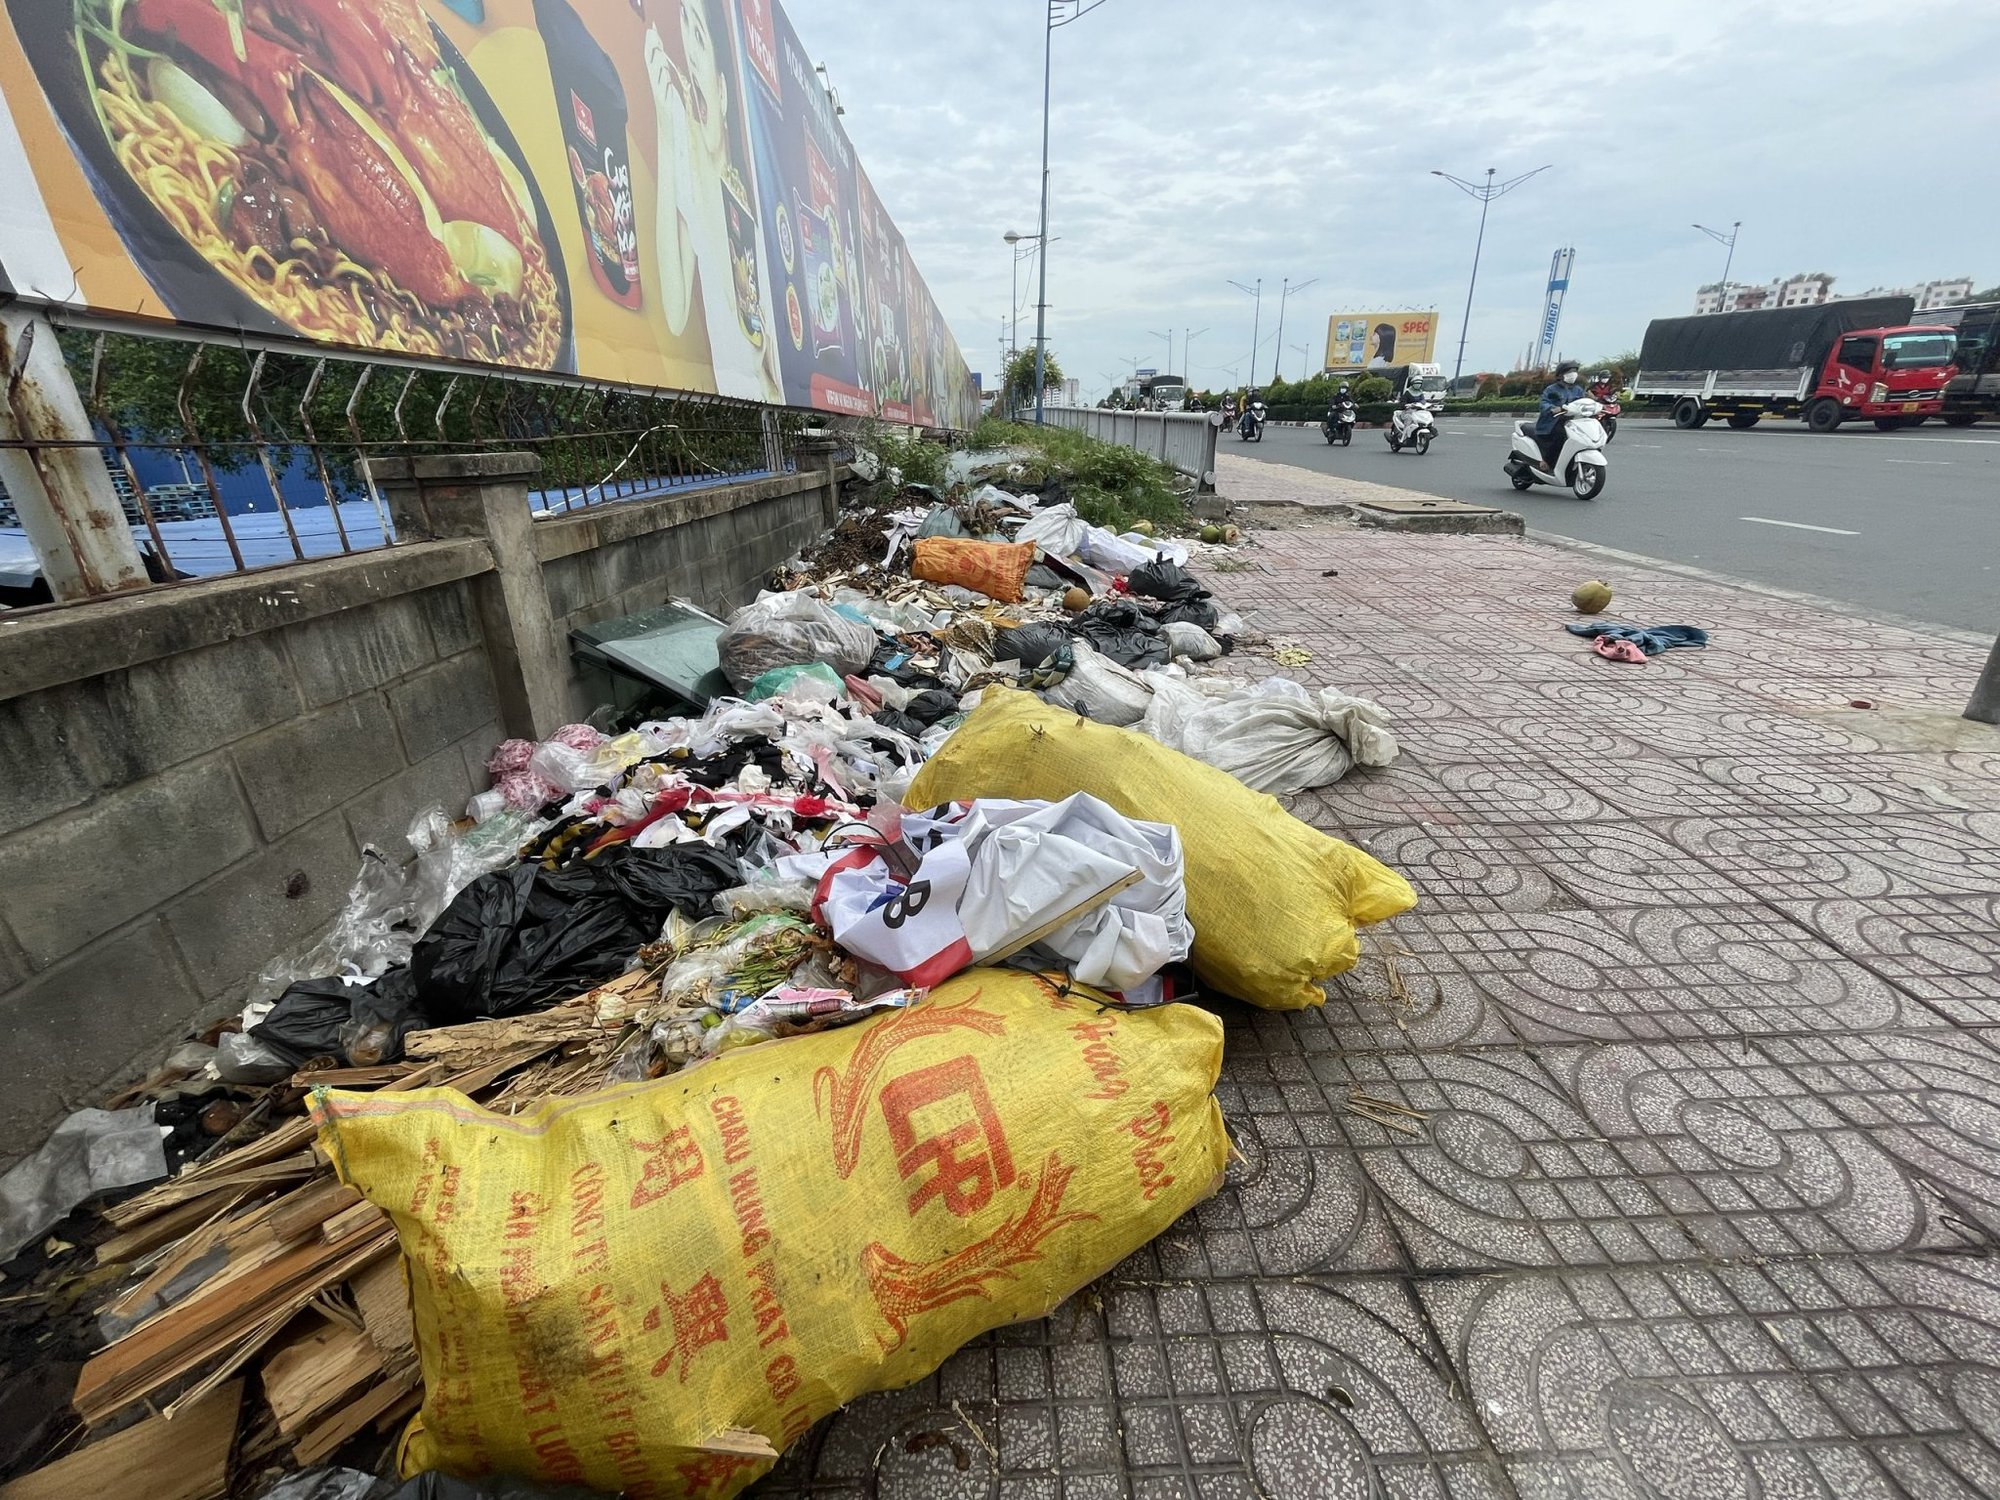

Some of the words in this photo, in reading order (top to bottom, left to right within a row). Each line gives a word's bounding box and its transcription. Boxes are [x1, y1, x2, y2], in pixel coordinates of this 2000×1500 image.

[746, 15, 778, 84] VIFON
[1403, 321, 1430, 334] SPEC
[1543, 302, 1559, 346] SAWACO
[728, 1165, 772, 1258] HUNG
